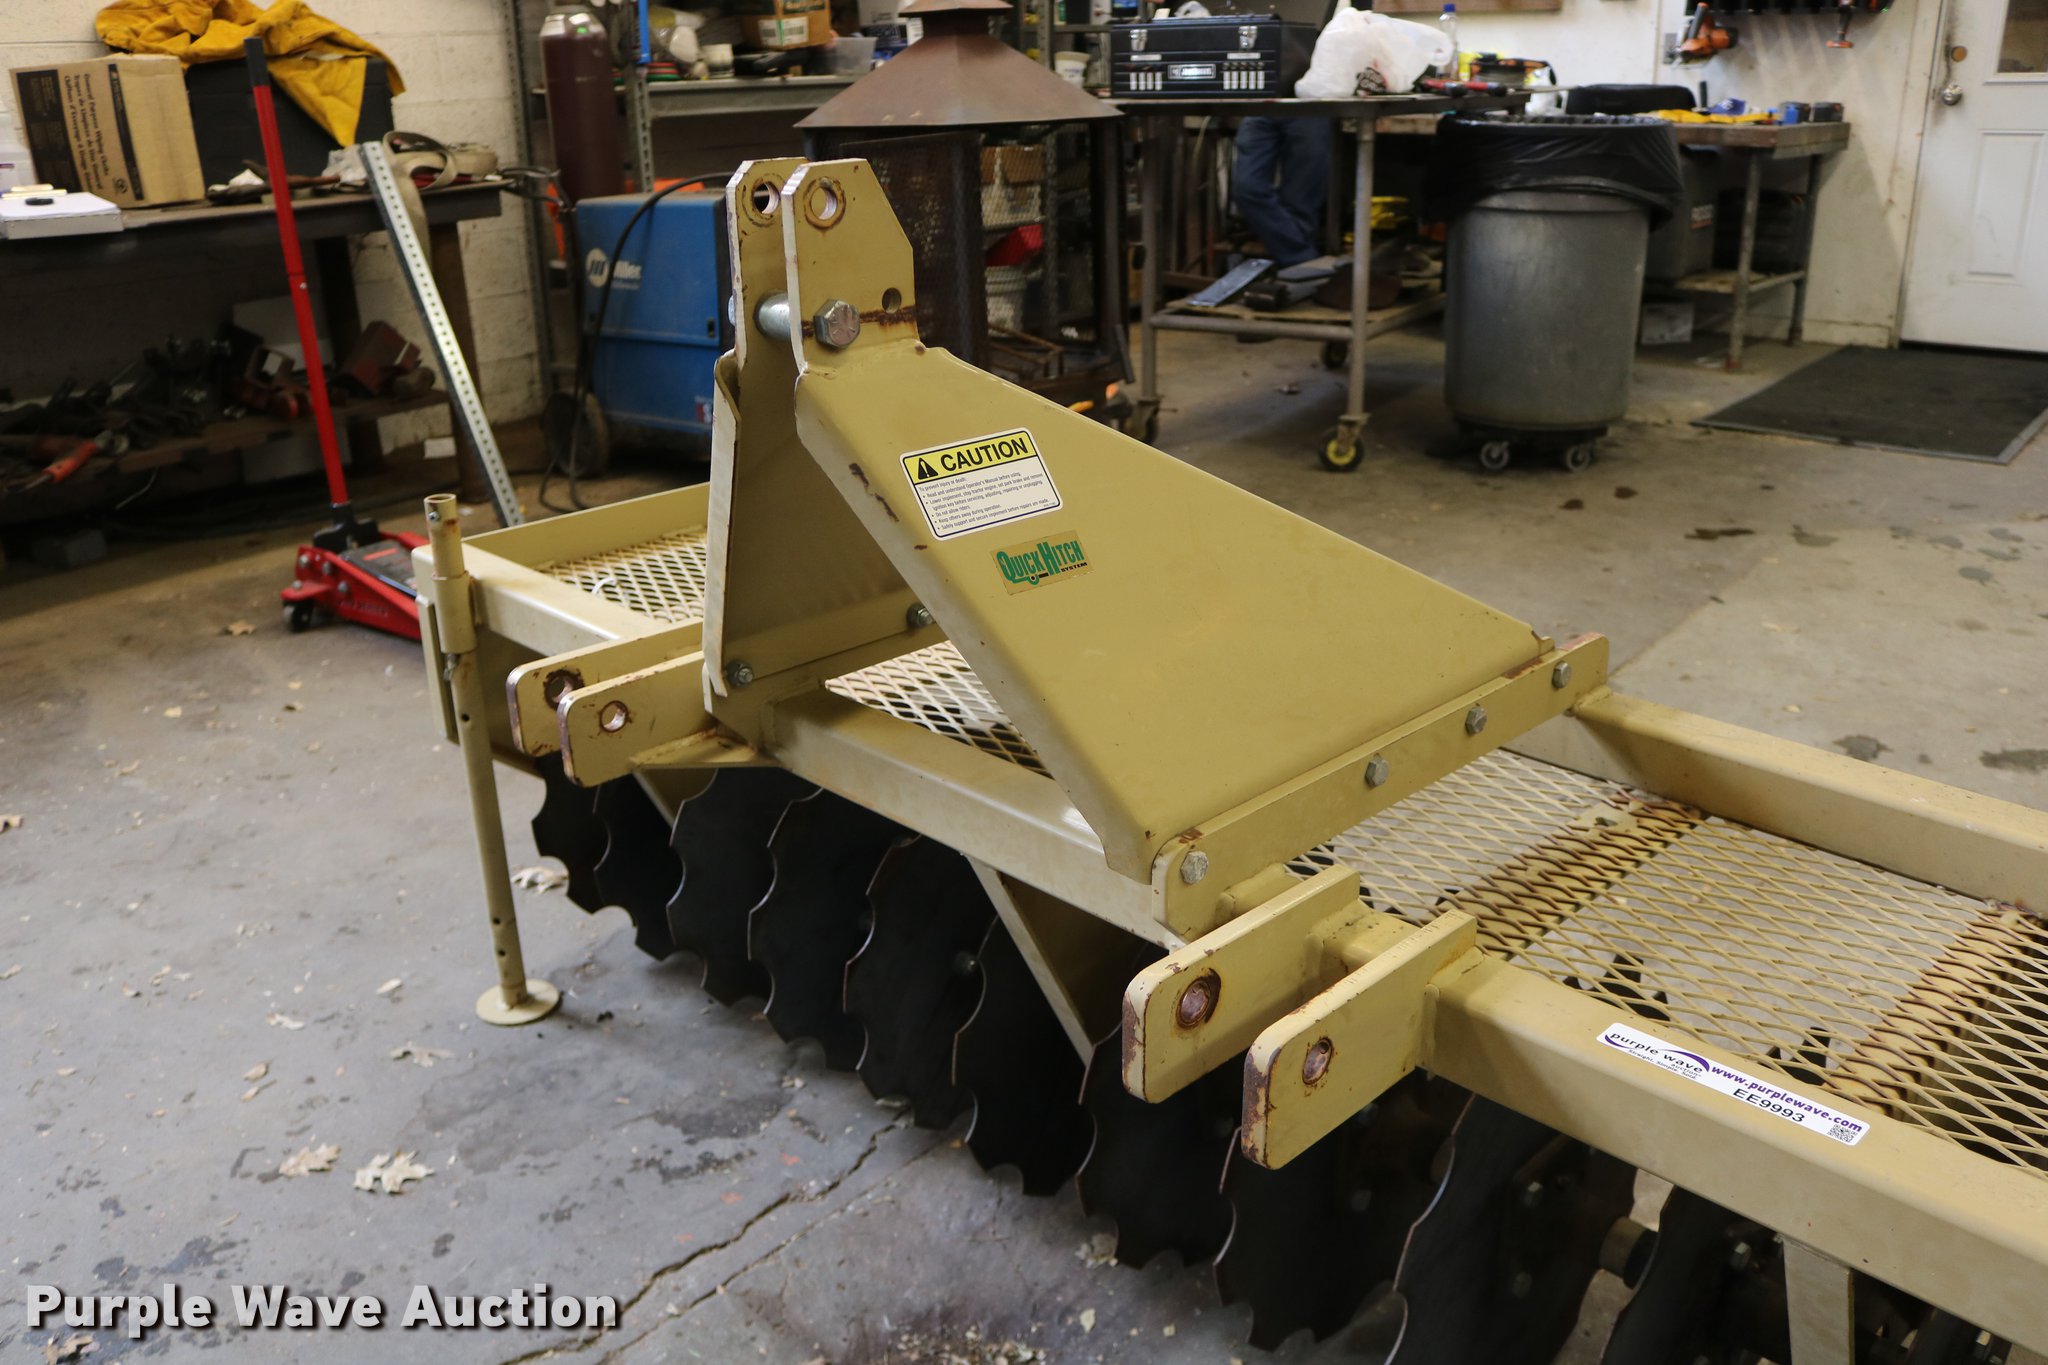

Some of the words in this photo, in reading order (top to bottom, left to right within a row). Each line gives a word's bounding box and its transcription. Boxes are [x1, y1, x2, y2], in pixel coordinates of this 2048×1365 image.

[940, 437, 1029, 472] CAUTION
[1060, 562, 1088, 572] SYSTEM
[1609, 1033, 1659, 1055] purple
[1663, 1054, 1703, 1074] wave
[1711, 1065, 1863, 1133] www.purplewave.com
[1732, 1088, 1806, 1123] EE9993
